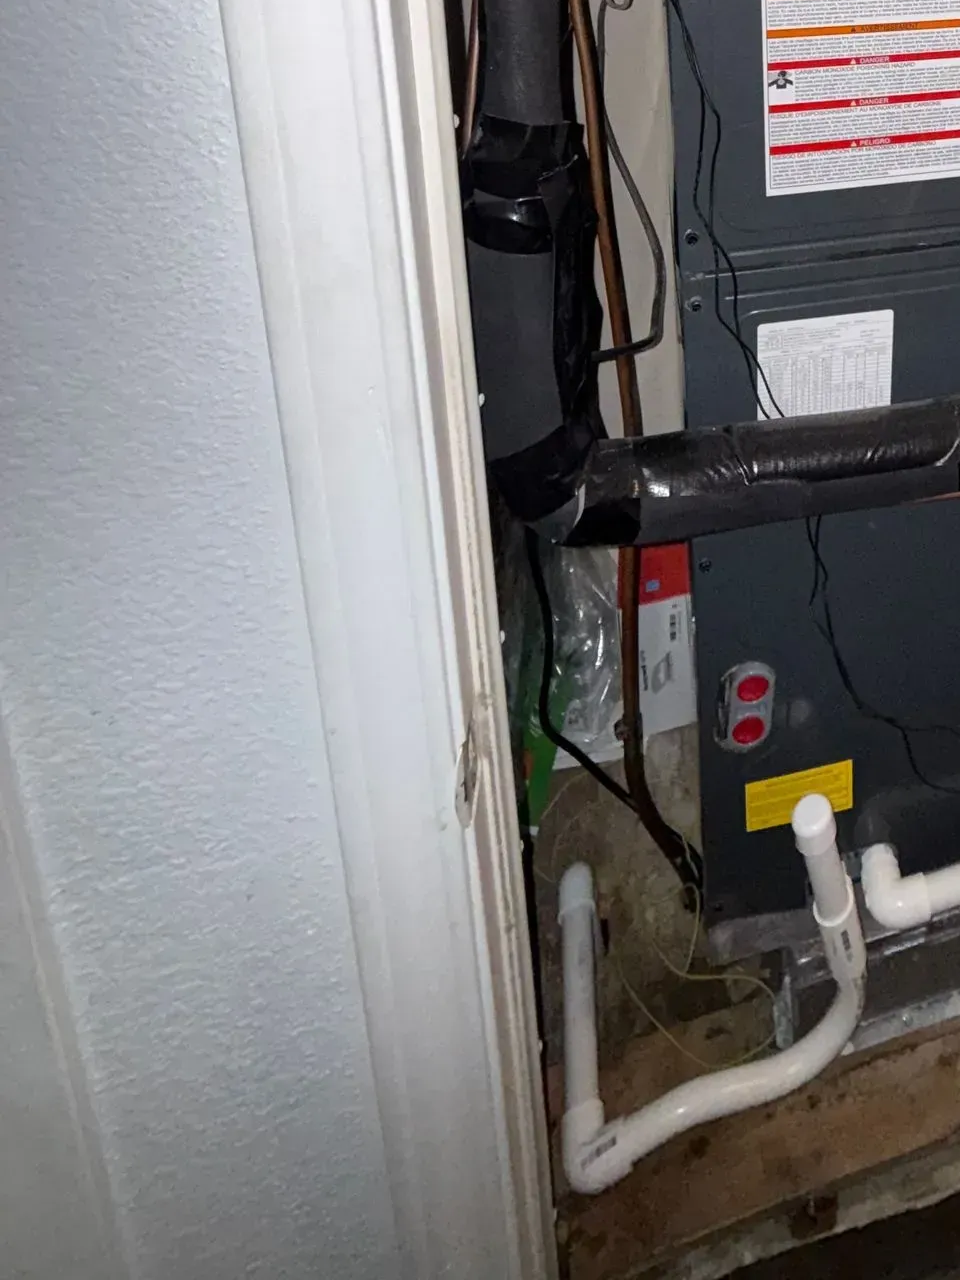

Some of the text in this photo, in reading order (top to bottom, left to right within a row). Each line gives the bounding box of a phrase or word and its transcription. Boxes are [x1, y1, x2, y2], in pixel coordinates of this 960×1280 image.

[861, 21, 918, 32] AVERTISSEMENT
[860, 56, 890, 64] DANGER
[860, 98, 889, 106] DANGER
[860, 138, 891, 147] PELIGRO
